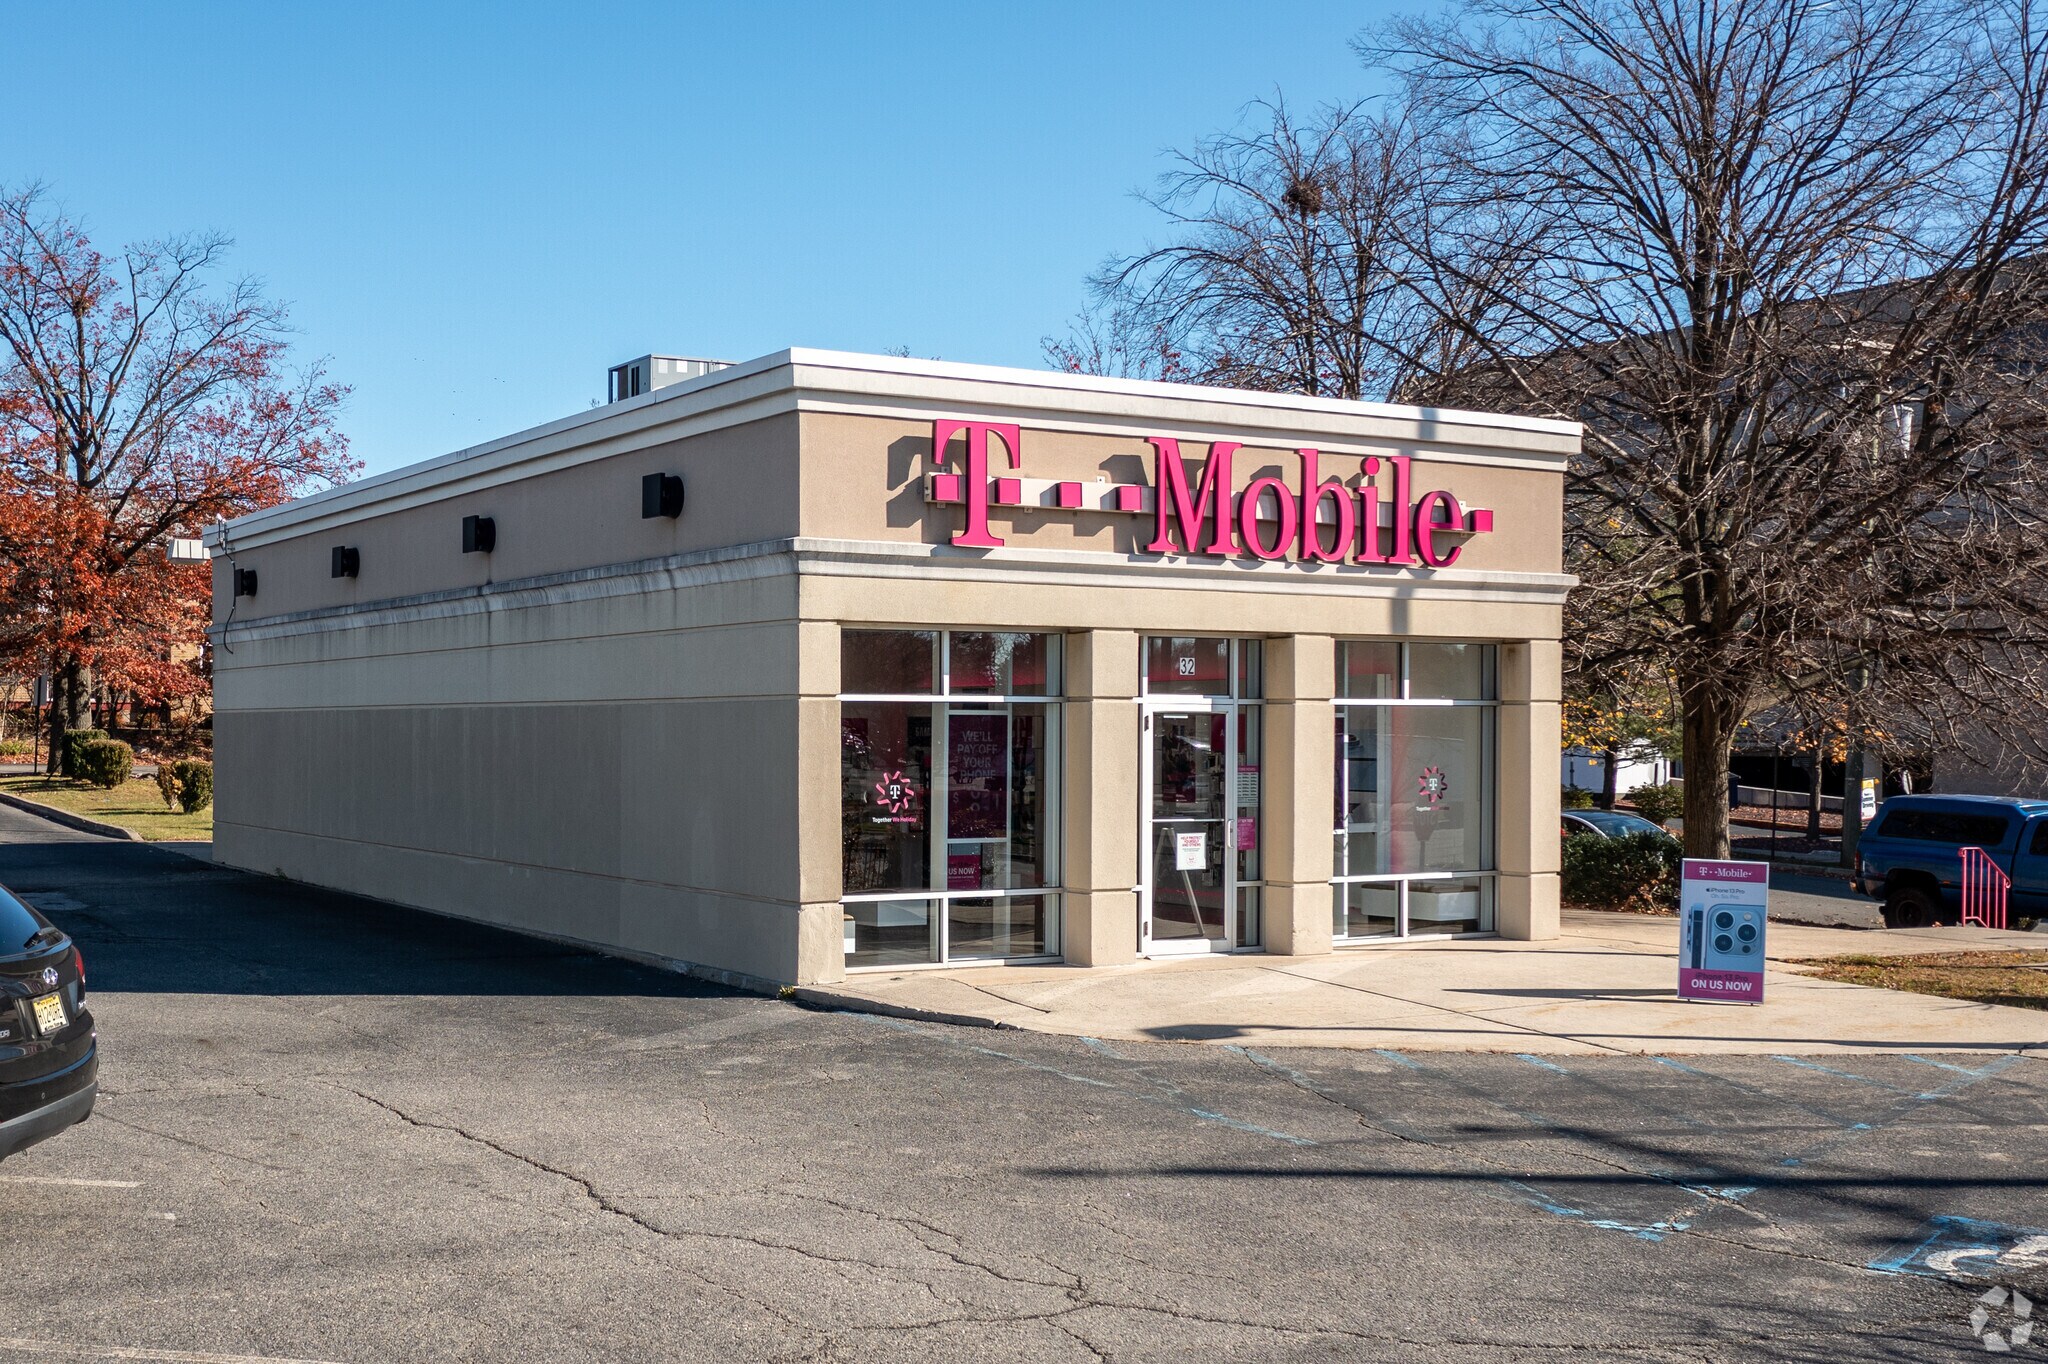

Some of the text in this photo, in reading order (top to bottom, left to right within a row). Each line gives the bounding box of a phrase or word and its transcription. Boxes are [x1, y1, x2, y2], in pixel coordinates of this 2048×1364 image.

[1180, 658, 1195, 675] 32
[957, 744, 998, 754] PAY OFF
[963, 757, 992, 768] YOUR
[958, 867, 975, 875] NOW
[1696, 972, 1722, 980] iPhone
[1691, 979, 1706, 989] ON
[1709, 980, 1723, 990] US
[1725, 981, 1752, 992] NOW
